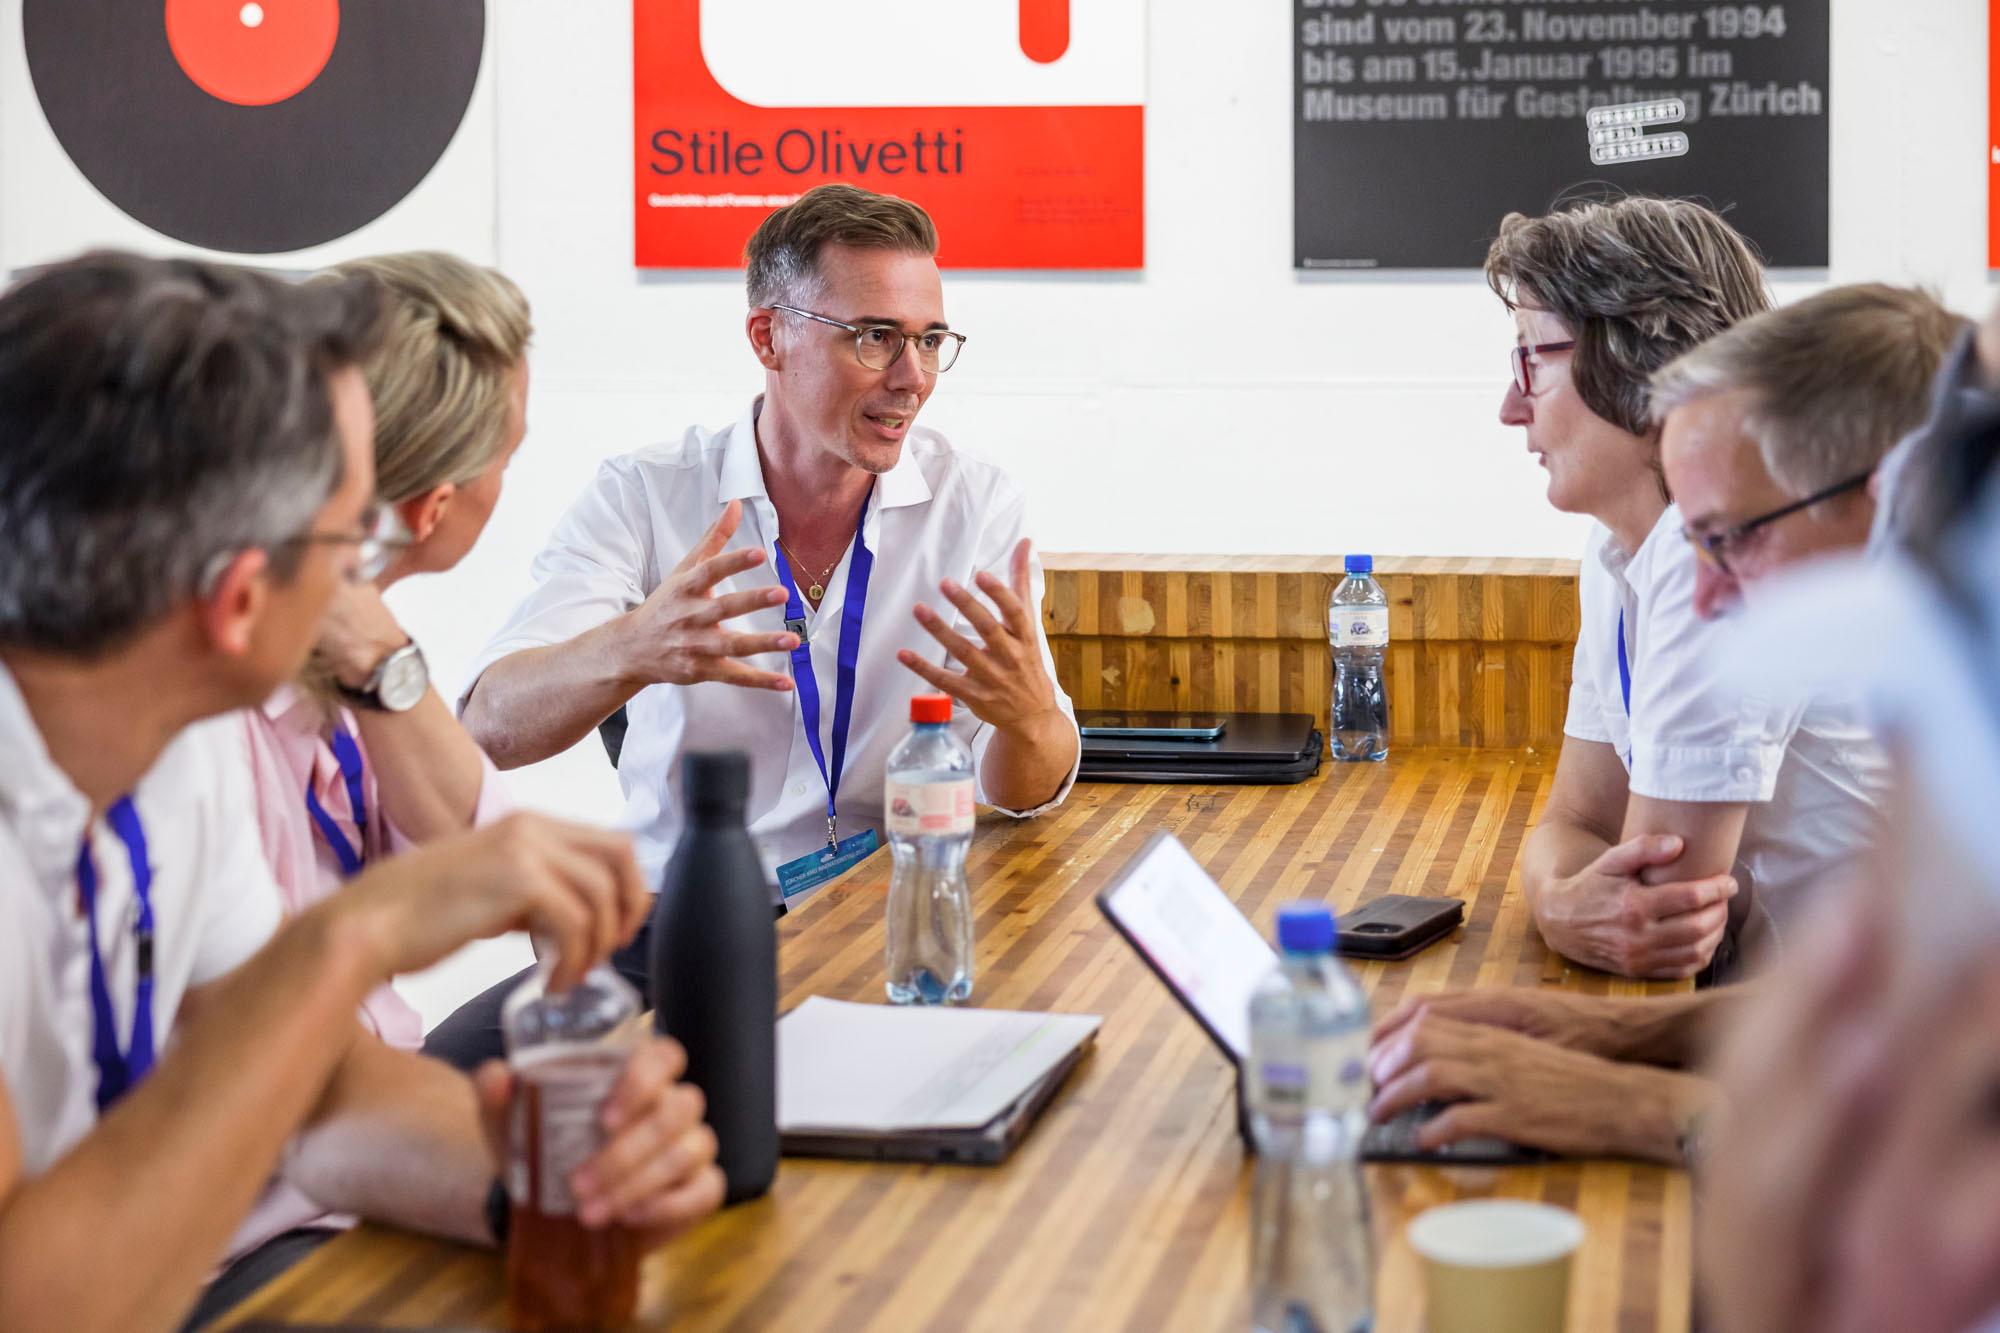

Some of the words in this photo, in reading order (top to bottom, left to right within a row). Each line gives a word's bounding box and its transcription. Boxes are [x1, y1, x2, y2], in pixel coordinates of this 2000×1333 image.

[1302, 12, 1375, 45] sind
[1382, 17, 1456, 43] vom
[1464, 9, 1517, 42] 23.
[1521, 7, 1698, 42] November
[1704, 4, 1787, 38] 1994
[1302, 50, 1355, 83] bis
[1361, 56, 1416, 82] am
[1472, 48, 1593, 81] Januar
[1597, 46, 1680, 78] 1995
[1687, 46, 1734, 76] im
[1302, 87, 1449, 121] Museum
[1455, 85, 1508, 118] für
[1707, 80, 1823, 116] Zürich
[650, 129, 764, 175] Stile
[775, 128, 963, 174] Olivetti
